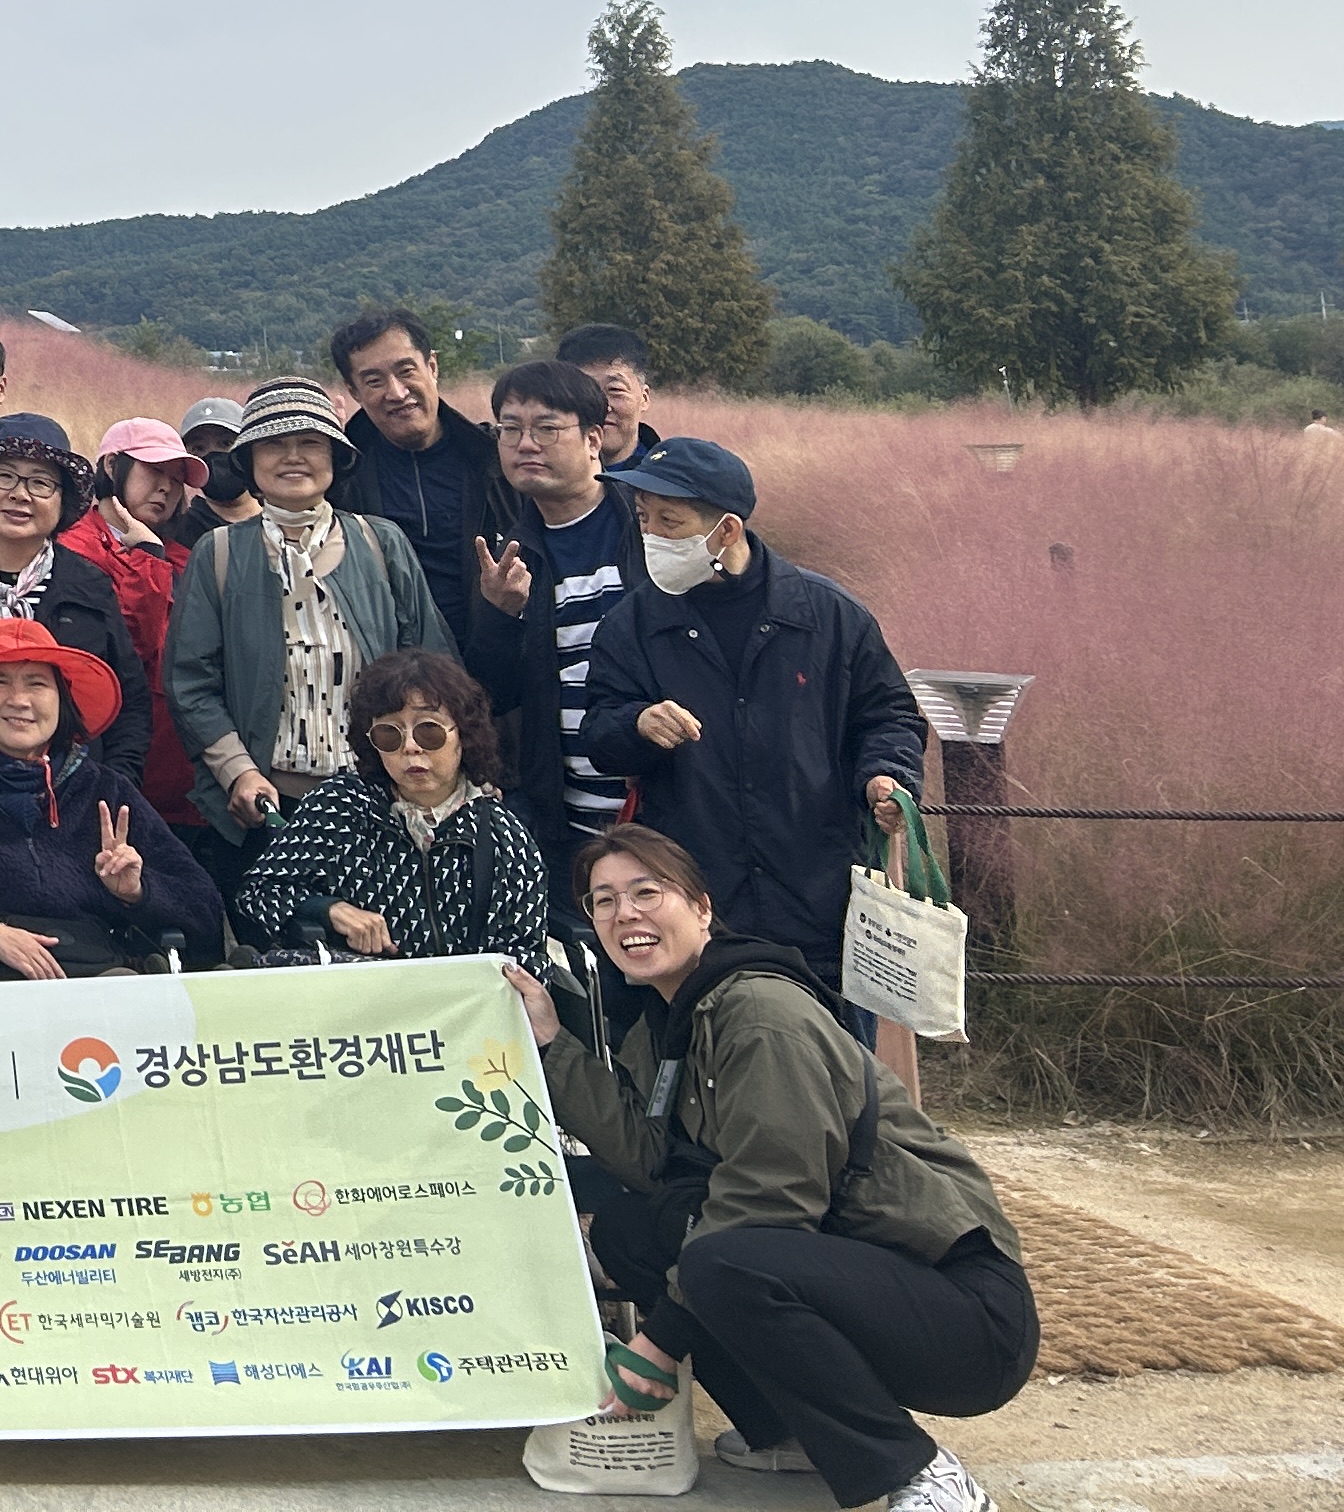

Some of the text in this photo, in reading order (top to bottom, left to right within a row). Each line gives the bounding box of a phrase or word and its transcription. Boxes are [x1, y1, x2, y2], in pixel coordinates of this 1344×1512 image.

[134, 1028, 446, 1089] 경상남도환경재단
[219, 1190, 272, 1214] 농협
[334, 1179, 478, 1206] 한화에어로스페이스
[22, 1196, 170, 1222] NEXEN TIRE
[15, 1243, 117, 1263] DOOSAN
[134, 1239, 241, 1265] SEBANG
[344, 1236, 462, 1259] 세아창원특수강
[20, 1268, 117, 1286] 두산에너빌리티
[230, 1303, 358, 1327] 한국자산관리공사
[405, 1293, 474, 1318] KISCO
[37, 1310, 161, 1330] 한국세라믹기술원
[243, 1361, 324, 1381] 해성디에스
[344, 1354, 392, 1377] KAI
[457, 1351, 570, 1376] 주택관리공단
[10, 1365, 79, 1386] 현대위아
[143, 1368, 194, 1386] 복지재단
